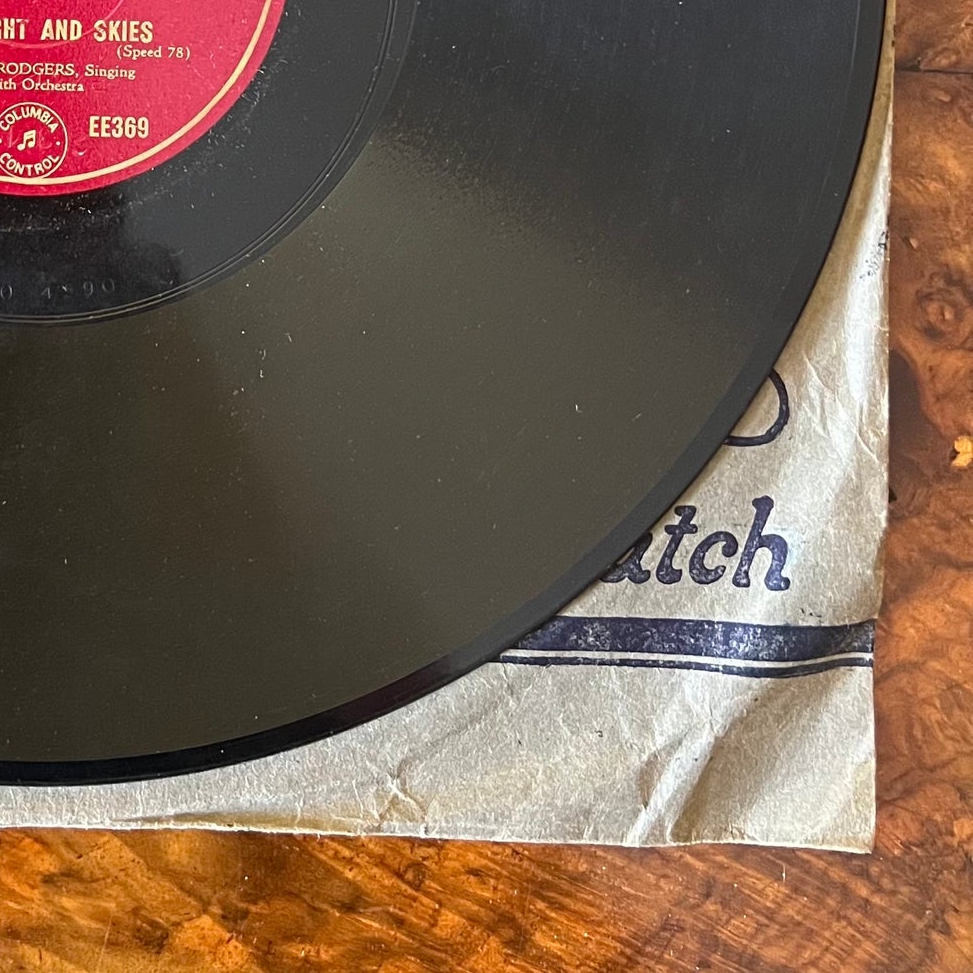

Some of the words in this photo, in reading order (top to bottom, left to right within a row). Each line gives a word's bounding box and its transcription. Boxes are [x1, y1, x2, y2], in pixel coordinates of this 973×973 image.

[41, 19, 82, 40] AND
[94, 20, 153, 43] SKIES
[117, 45, 162, 60] (Speed
[168, 47, 190, 60] 78)
[85, 64, 135, 80] Singing
[22, 78, 84, 91] Orchestra
[0, 106, 59, 133] COLUMBIA
[89, 116, 149, 138] EE369
[0, 152, 60, 176] CONTROL
